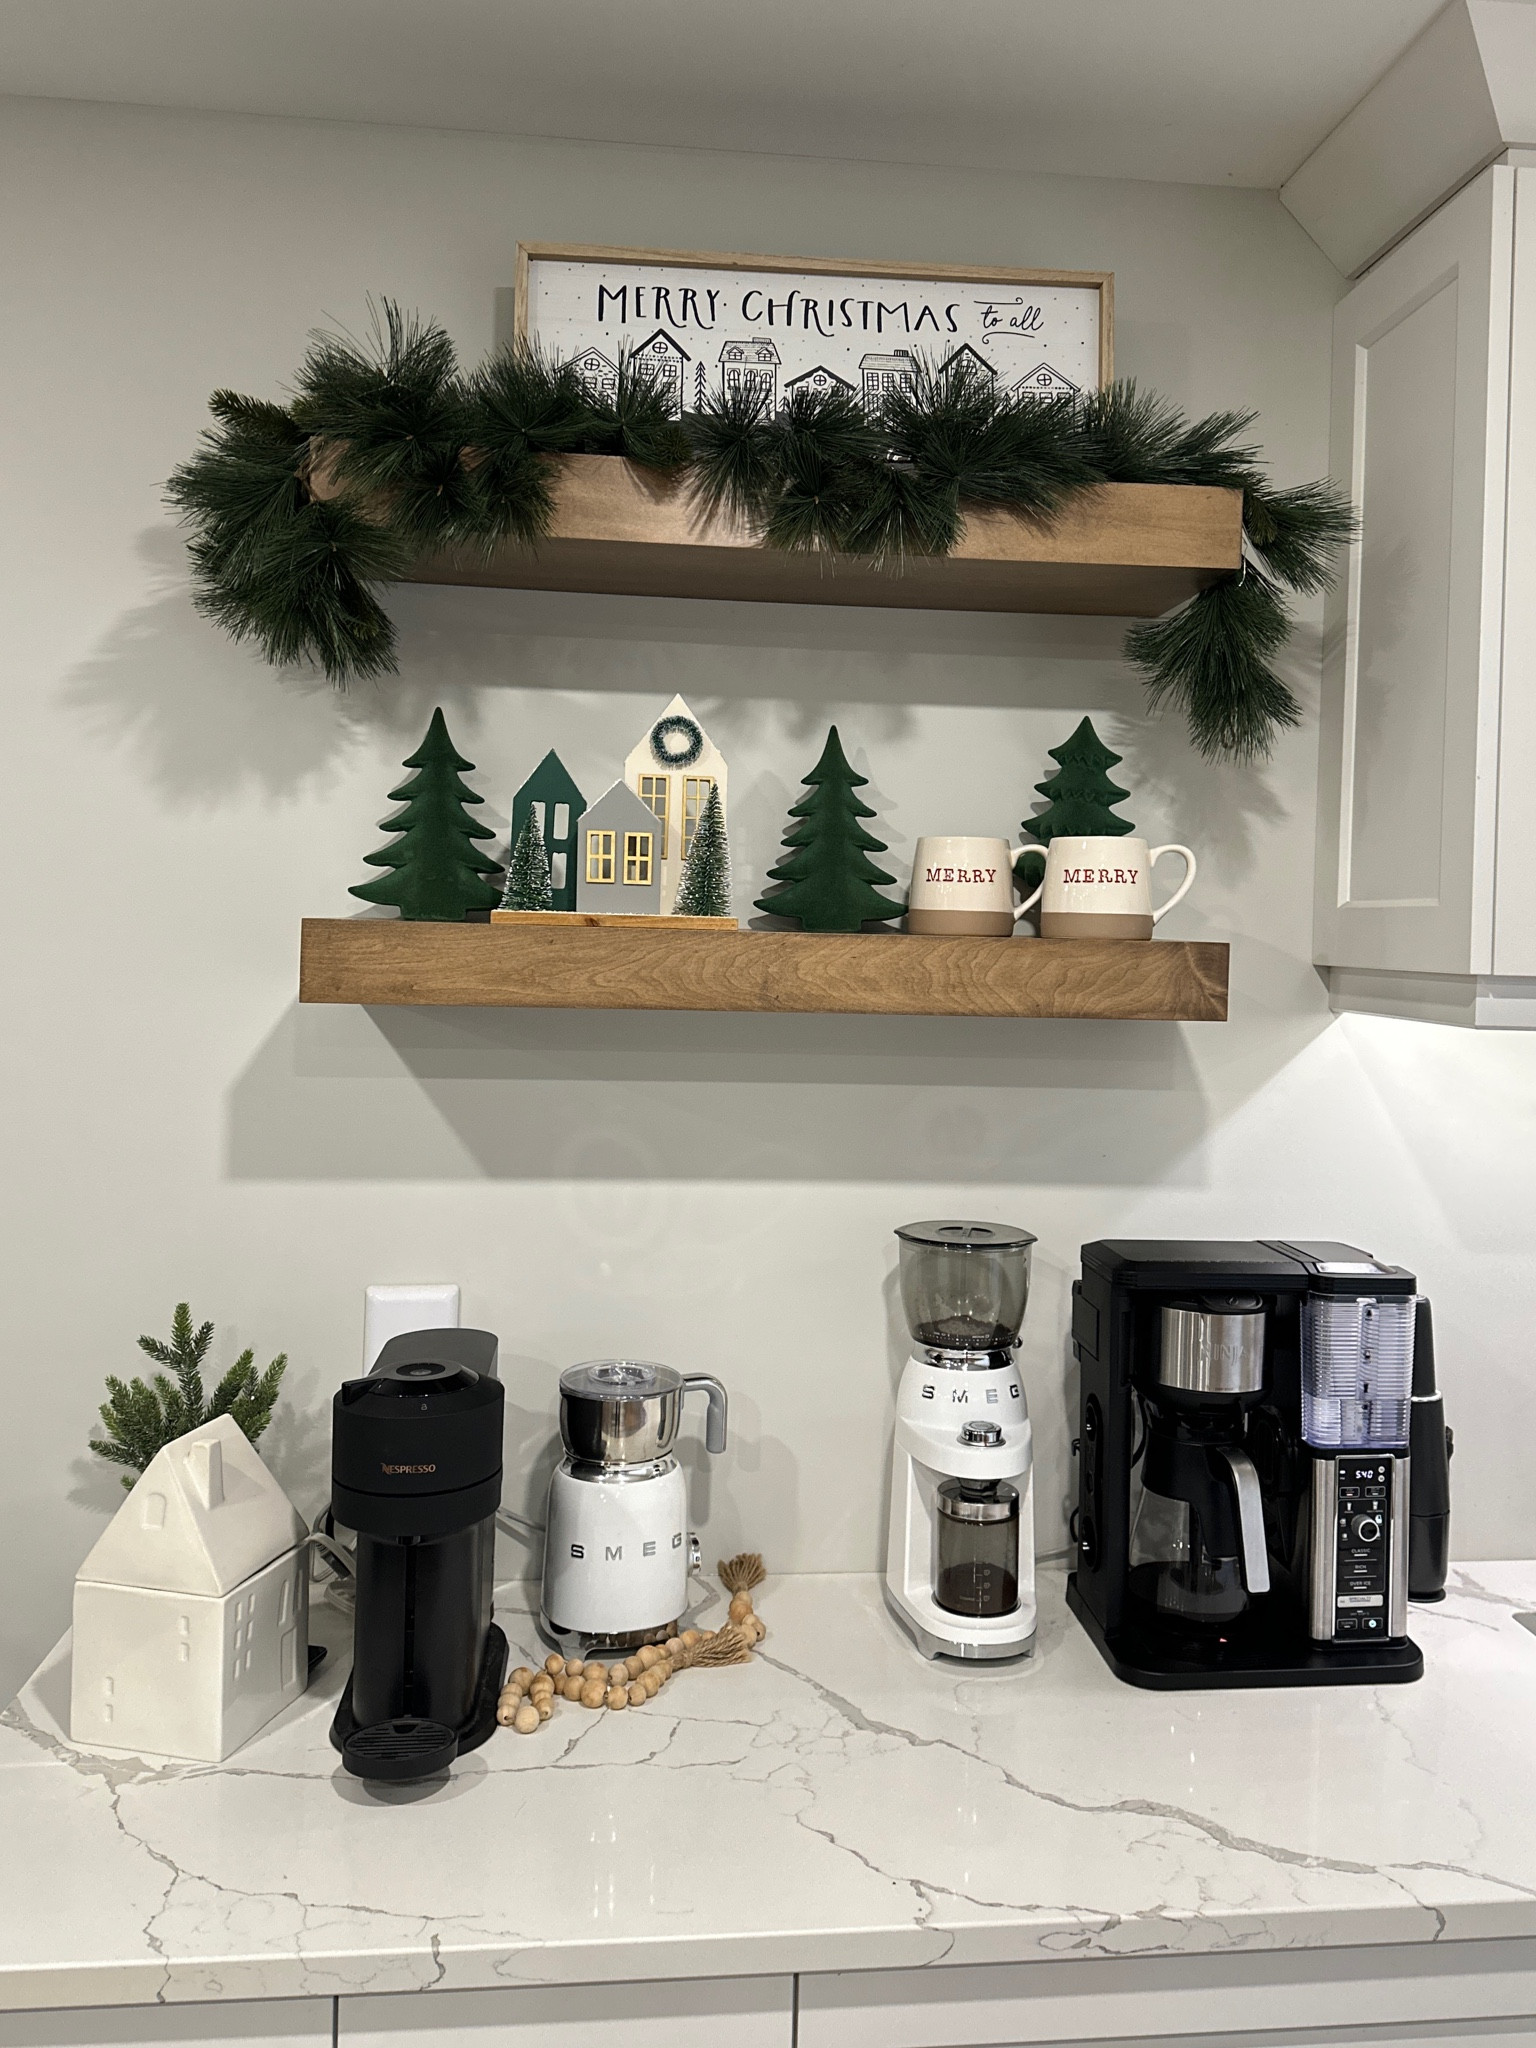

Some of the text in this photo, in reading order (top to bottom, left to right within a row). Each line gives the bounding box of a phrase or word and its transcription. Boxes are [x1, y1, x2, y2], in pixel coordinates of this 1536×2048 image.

[599, 284, 1046, 337] MERRY CHRISTMAS to all
[926, 868, 997, 883] MERRY
[1063, 869, 1139, 884] MERRY
[921, 1384, 1020, 1404] SMEG
[380, 1462, 436, 1475] NESPRESSO
[570, 1532, 682, 1561] SMEG
